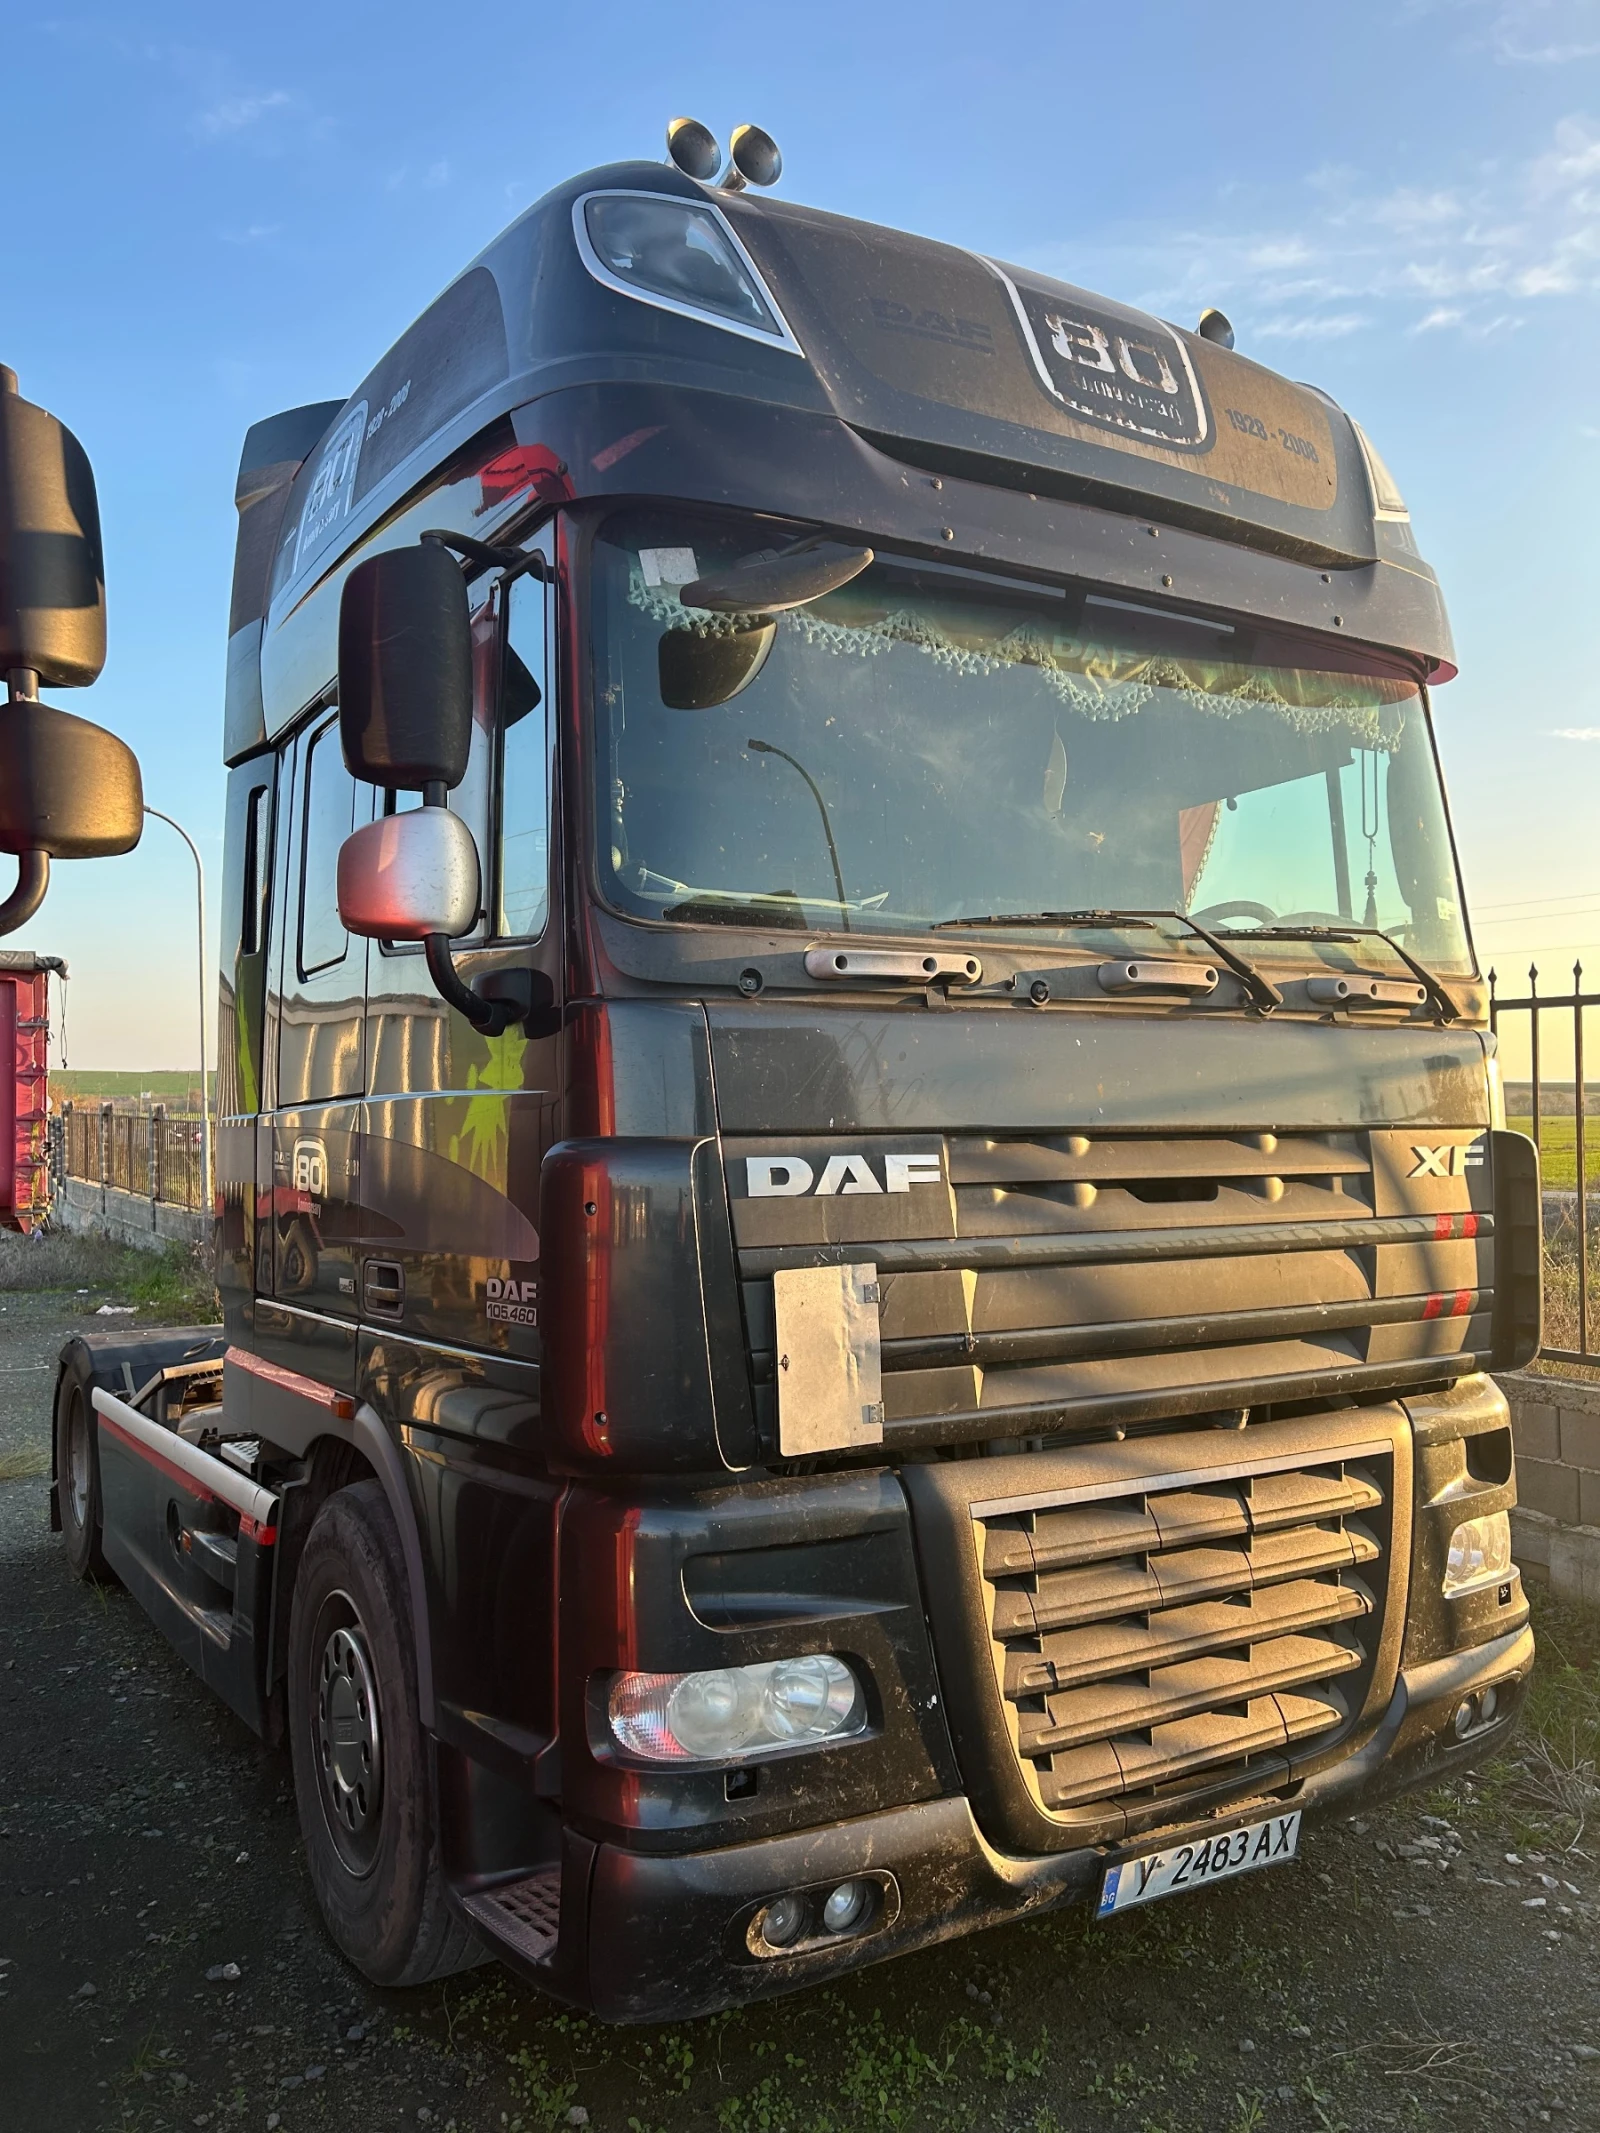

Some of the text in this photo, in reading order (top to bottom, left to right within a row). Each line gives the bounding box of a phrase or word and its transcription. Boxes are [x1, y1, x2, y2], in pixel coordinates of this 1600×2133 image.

[1043, 311, 1179, 396] 80
[1225, 408, 1268, 441] 1928
[1278, 427, 1320, 463] 2008
[1051, 634, 1139, 668] DAF
[297, 1154, 322, 1195] 80
[745, 1154, 941, 1197] DAF
[1407, 1144, 1484, 1178] XF
[486, 1278, 537, 1303] DAF
[487, 1303, 536, 1324] 105.460
[1170, 1830, 1250, 1886] 2483
[1251, 1815, 1296, 1861] AX
[1101, 1892, 1115, 1907] BG
